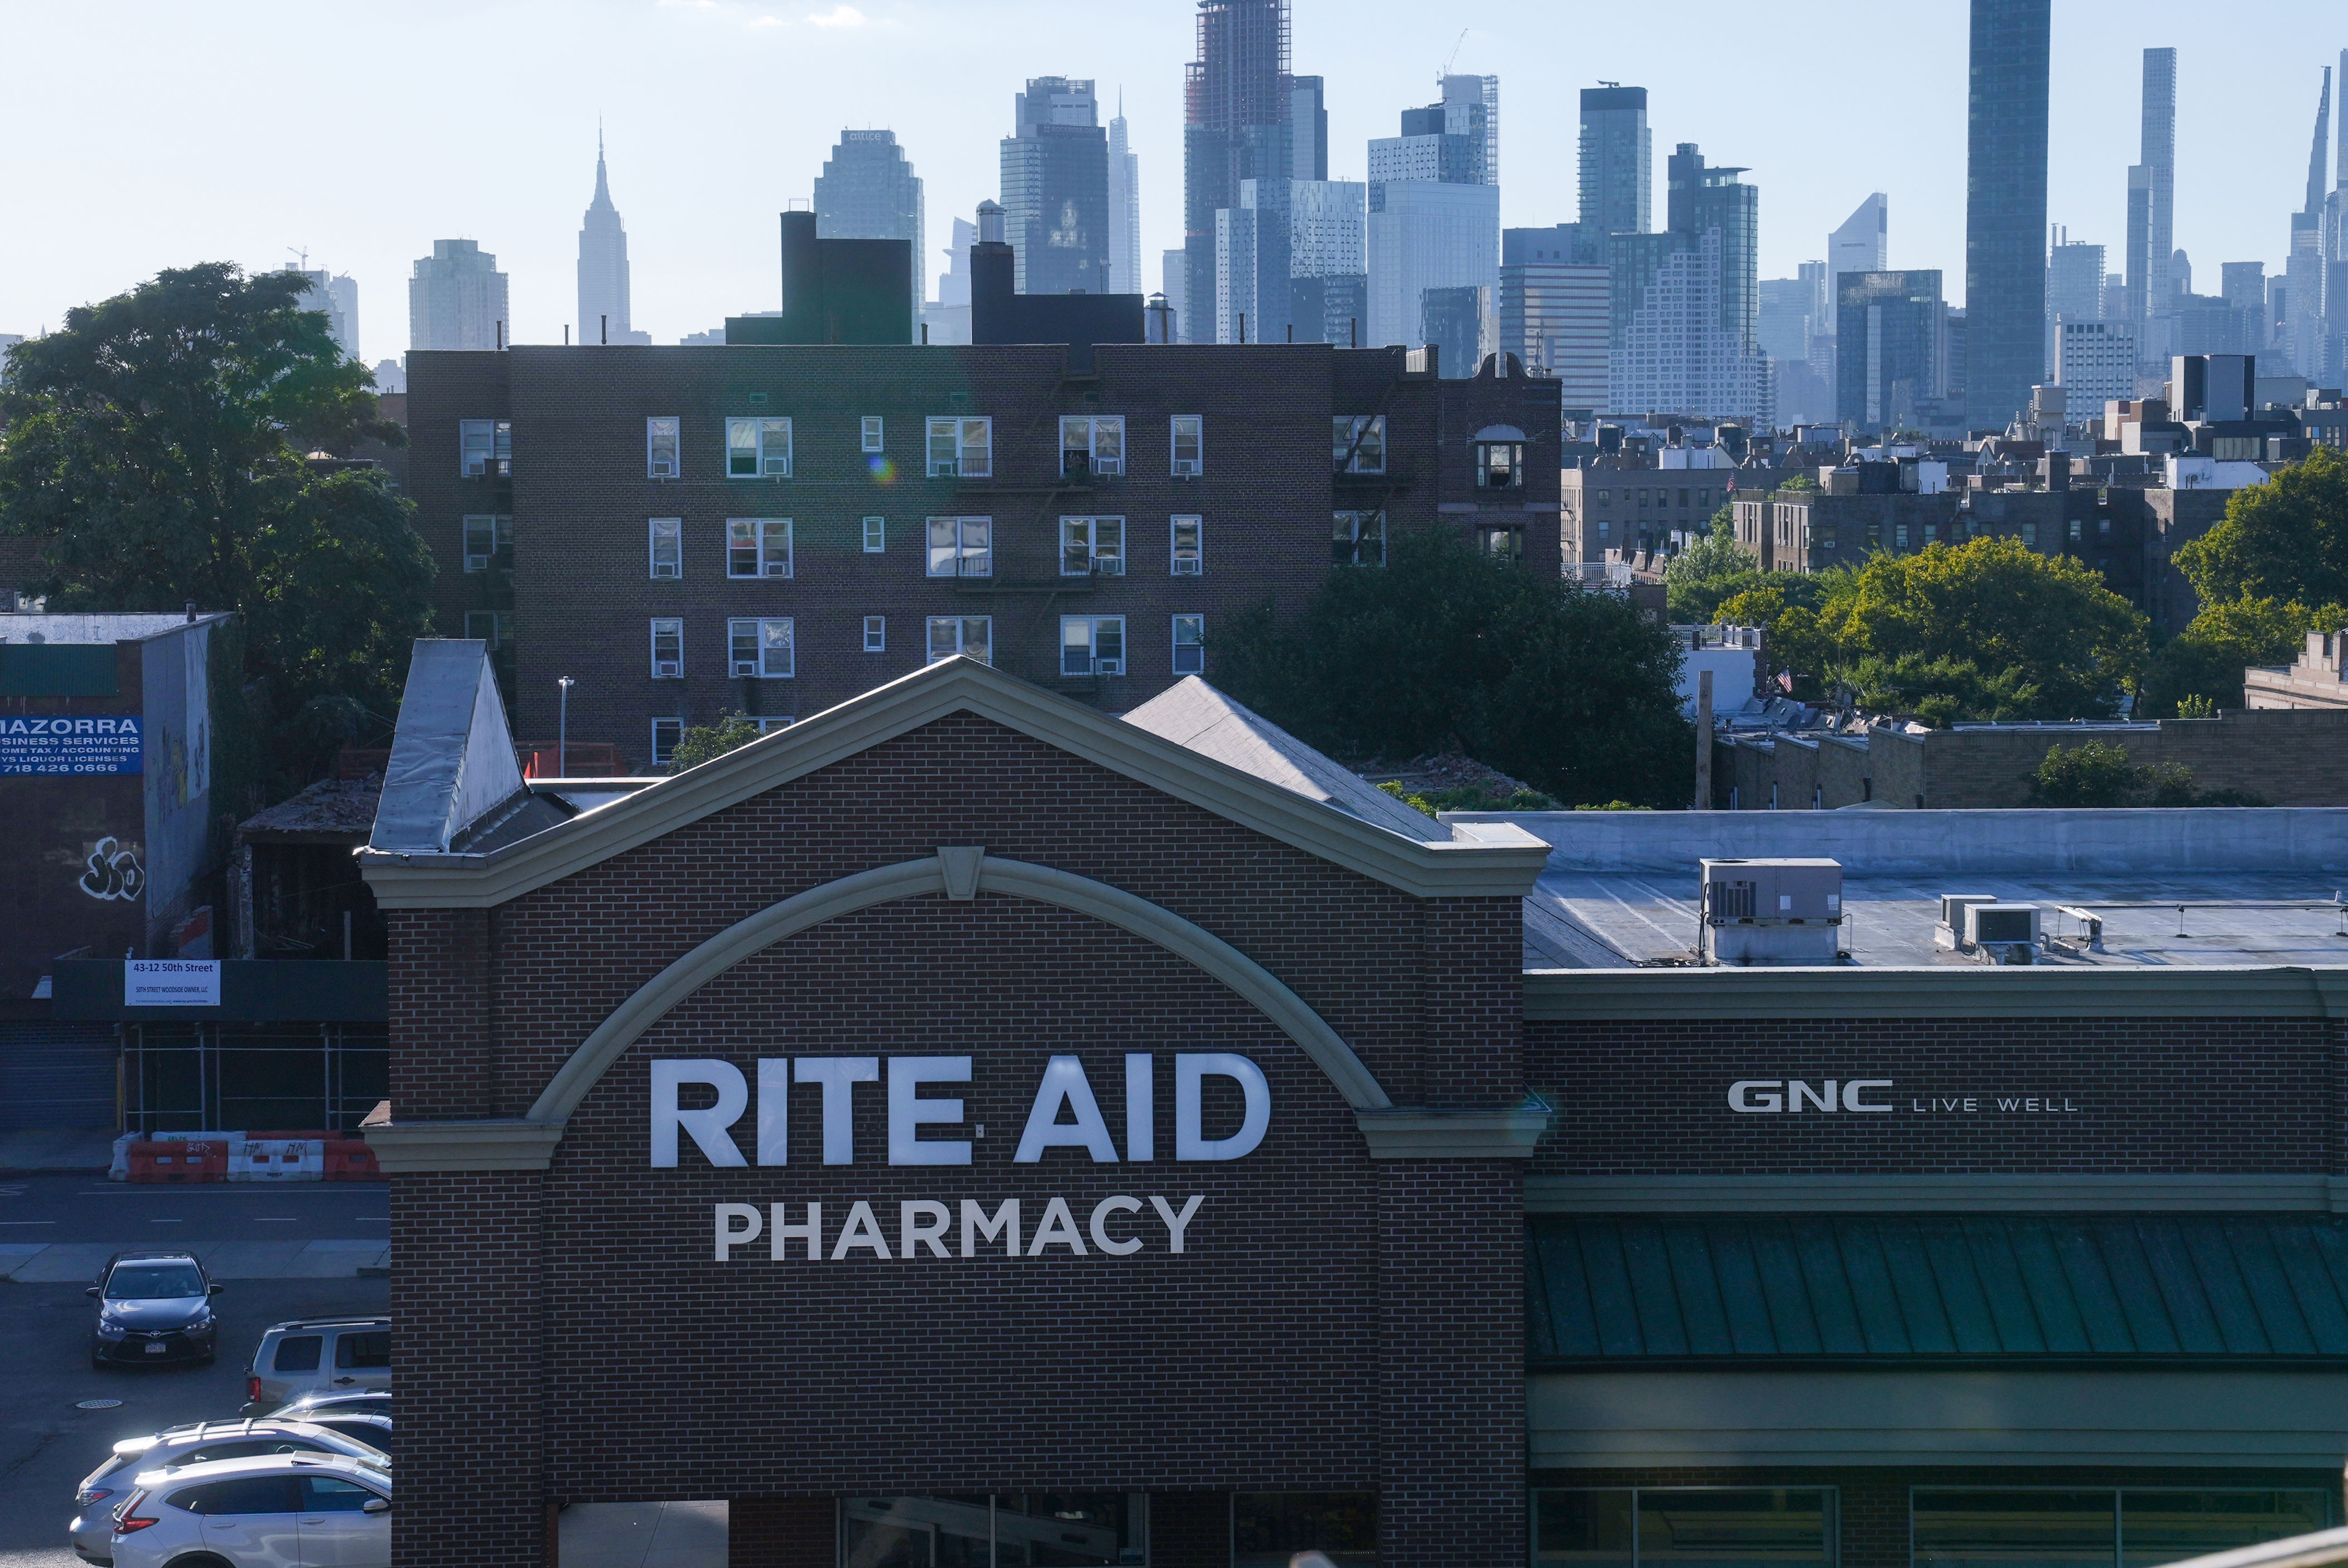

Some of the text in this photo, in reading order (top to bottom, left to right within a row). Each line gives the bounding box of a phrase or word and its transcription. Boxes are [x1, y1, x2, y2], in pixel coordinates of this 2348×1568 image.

[849, 131, 881, 140] altice
[134, 962, 213, 972] 43-12 50th Street
[650, 1053, 1271, 1167] RITE AID
[1728, 1080, 2078, 1112] GNC LIVE WELL
[715, 1195, 1206, 1262] PHARMACY
